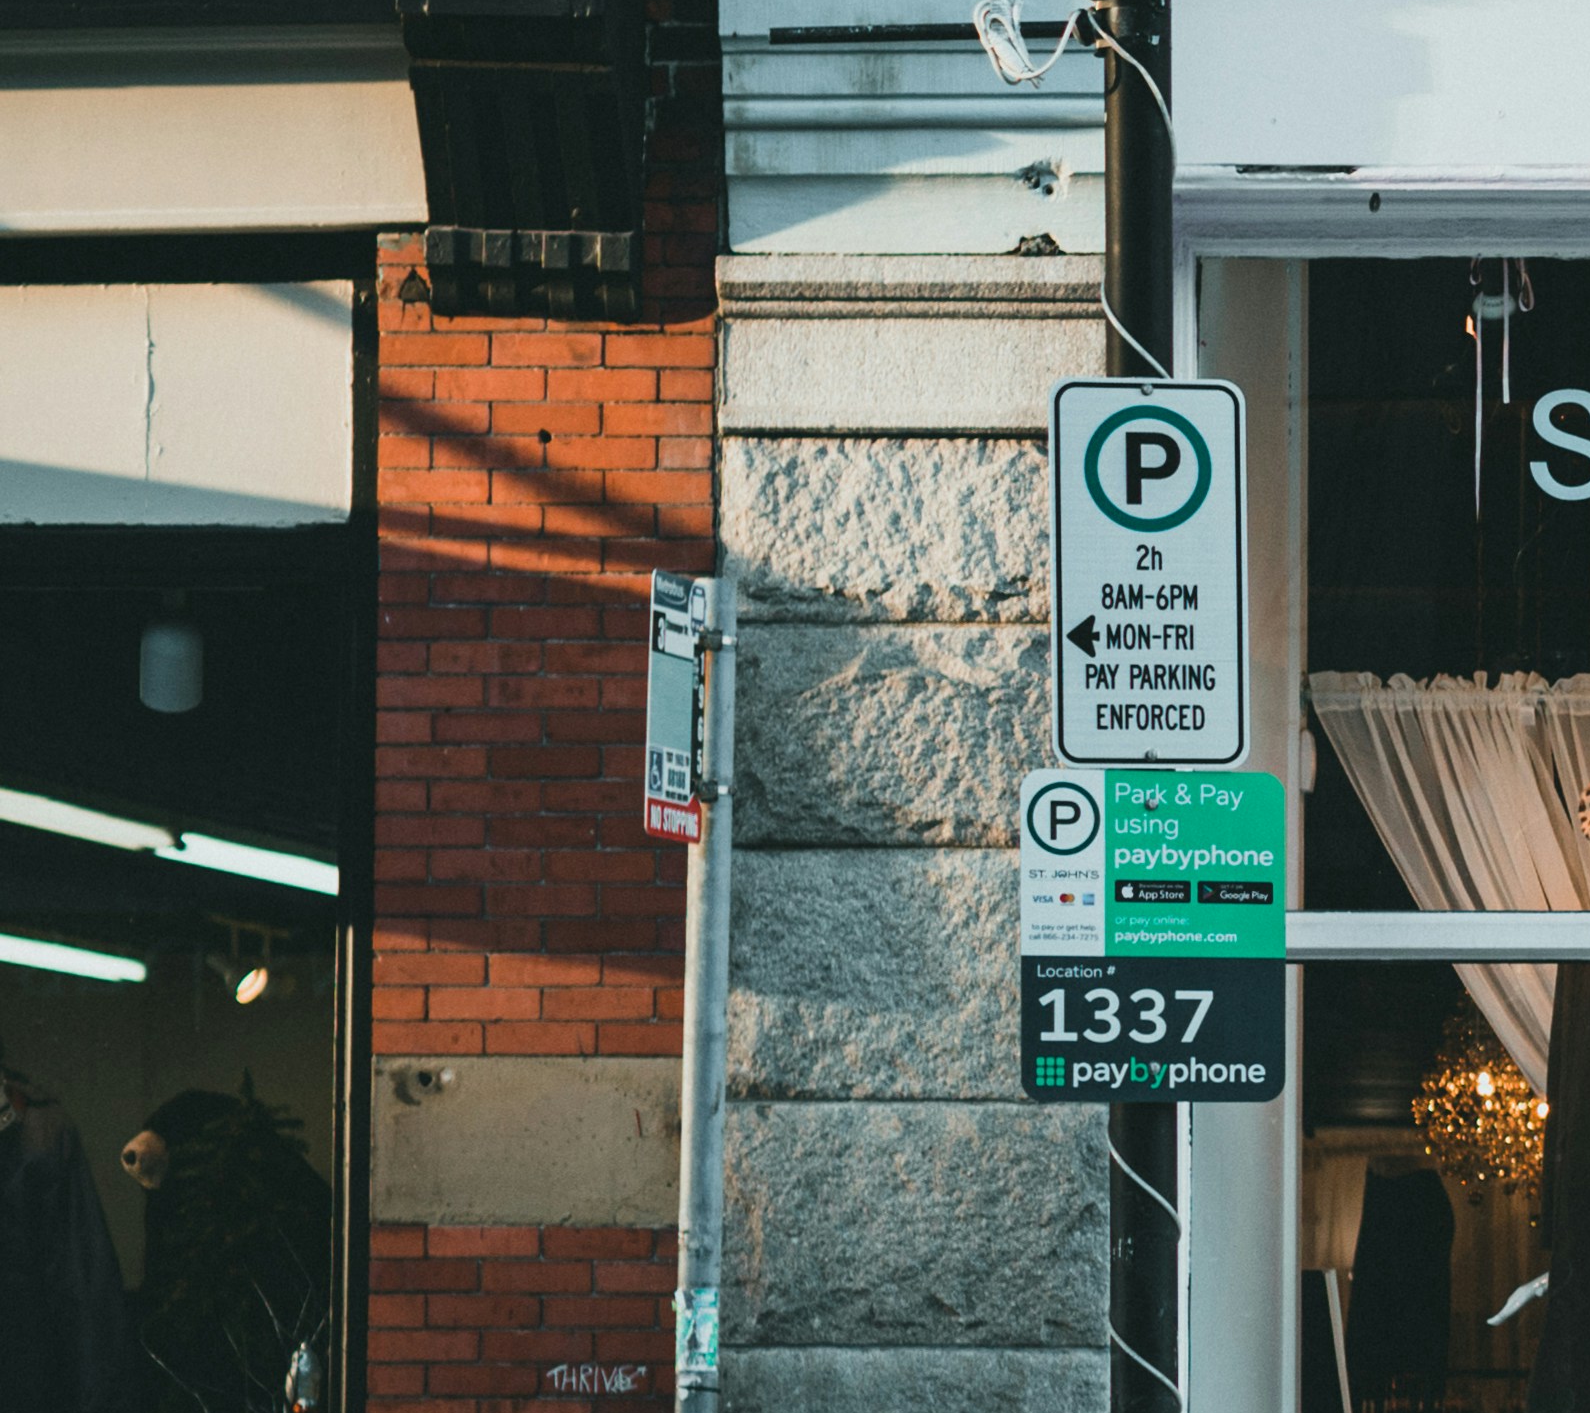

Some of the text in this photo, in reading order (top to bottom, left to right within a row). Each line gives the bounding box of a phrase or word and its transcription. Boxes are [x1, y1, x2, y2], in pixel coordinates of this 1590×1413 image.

[1125, 432, 1181, 505] P
[1136, 544, 1163, 571] 2h
[1101, 583, 1198, 610] 8AM-6PM
[1106, 623, 1195, 651] MON-FRI
[1085, 663, 1216, 691] PAY PARKING
[1096, 704, 1206, 731] ENFORCED
[1114, 782, 1244, 811] Park & Pay
[650, 803, 698, 838] NO STOPPING
[1050, 800, 1081, 840] P
[1114, 813, 1179, 840] using
[1114, 843, 1274, 871] paybyphone
[1029, 869, 1047, 879] ST.
[1032, 895, 1054, 903] VISA
[1138, 889, 1185, 901] App Store
[1220, 890, 1269, 901] Google Play
[1066, 924, 1079, 932] get
[1115, 916, 1190, 928] or pay online:
[1114, 930, 1238, 944] paybyphone.com
[1037, 964, 1116, 978] Location #
[1038, 987, 1214, 1044] 1337
[1072, 1056, 1266, 1089] paybyphone
